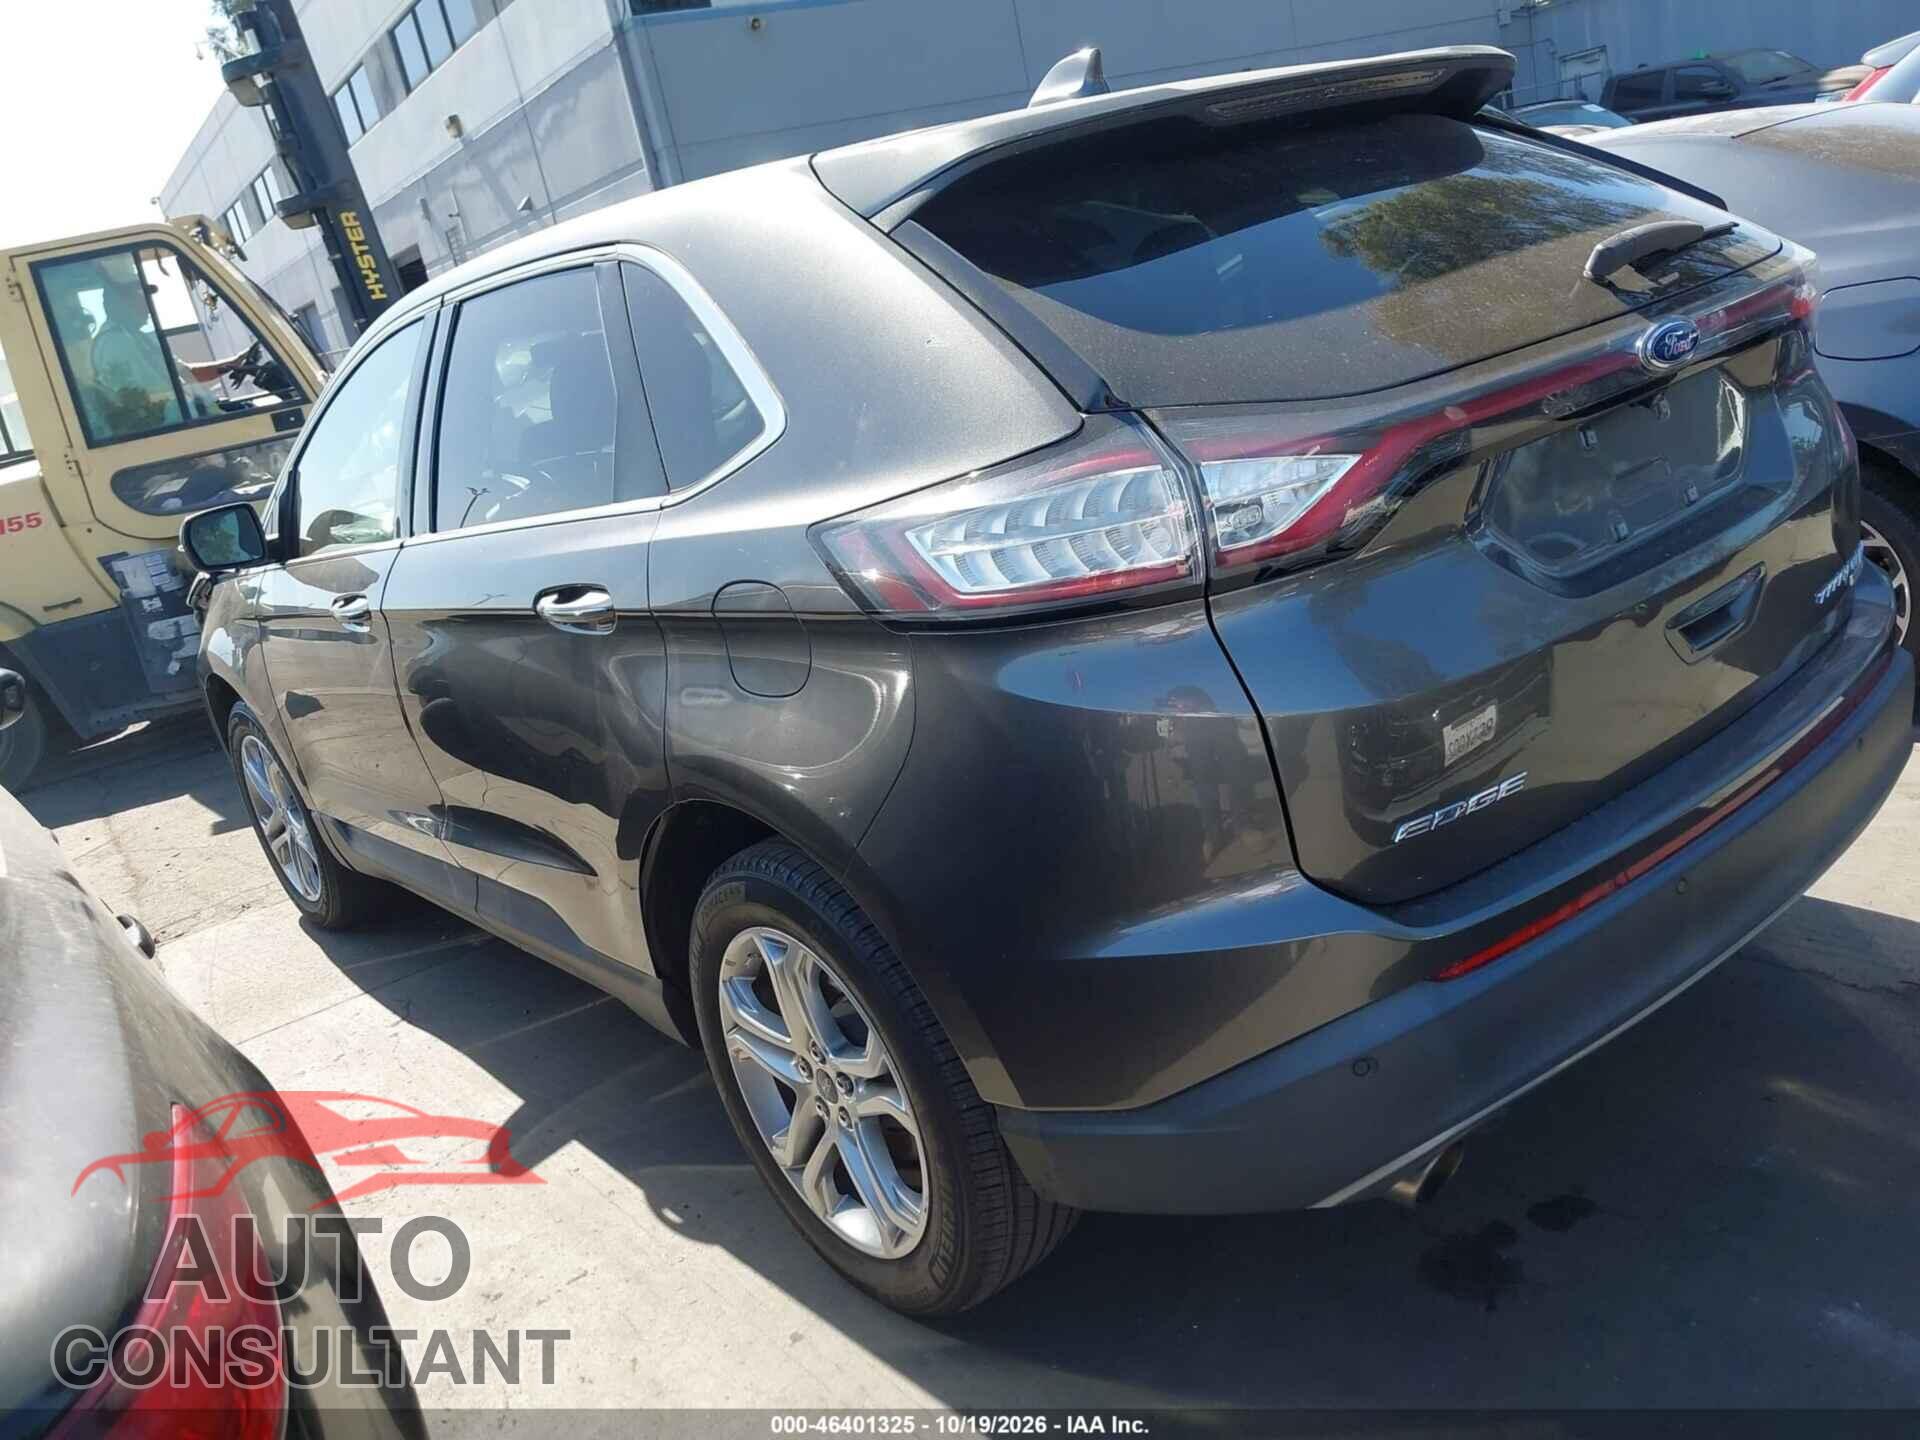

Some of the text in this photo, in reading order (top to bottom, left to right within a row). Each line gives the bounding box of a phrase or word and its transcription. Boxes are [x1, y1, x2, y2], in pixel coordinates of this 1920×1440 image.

[339, 211, 388, 300] HYSTER
[1664, 330, 1699, 360] Ford
[1393, 770, 1528, 843] EDGE
